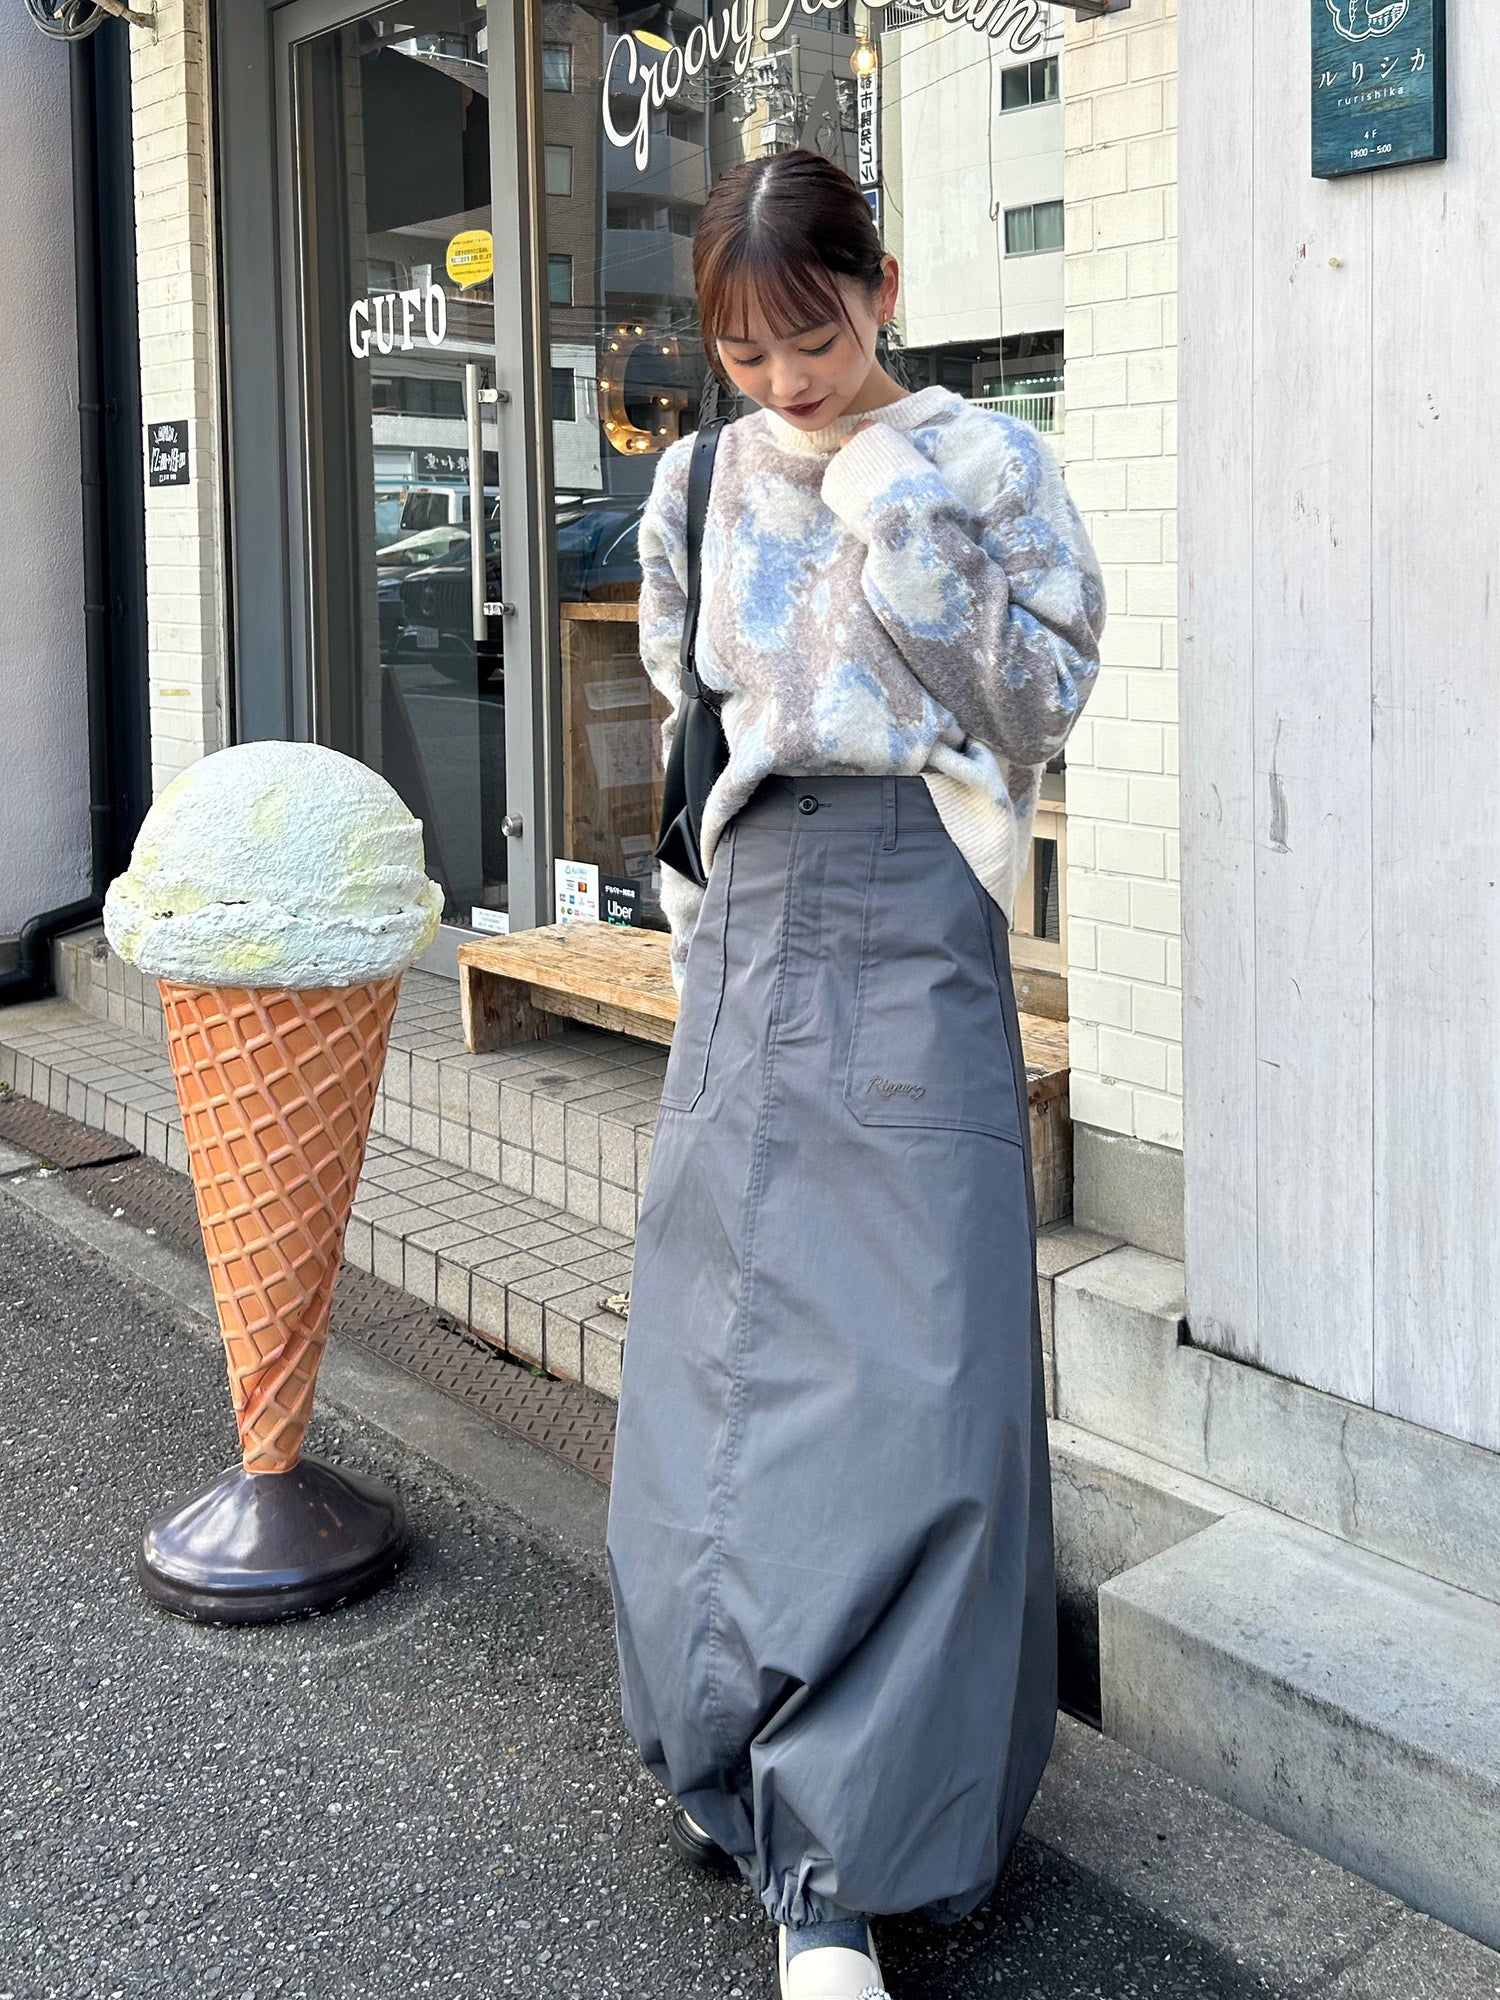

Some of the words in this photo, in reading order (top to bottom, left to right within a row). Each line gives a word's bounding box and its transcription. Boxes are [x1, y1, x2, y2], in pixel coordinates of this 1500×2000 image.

[603, 0, 754, 171] Groovy
[1338, 87, 1404, 106] rurishika
[350, 283, 446, 358] GUFO
[608, 900, 632, 919] Uber
